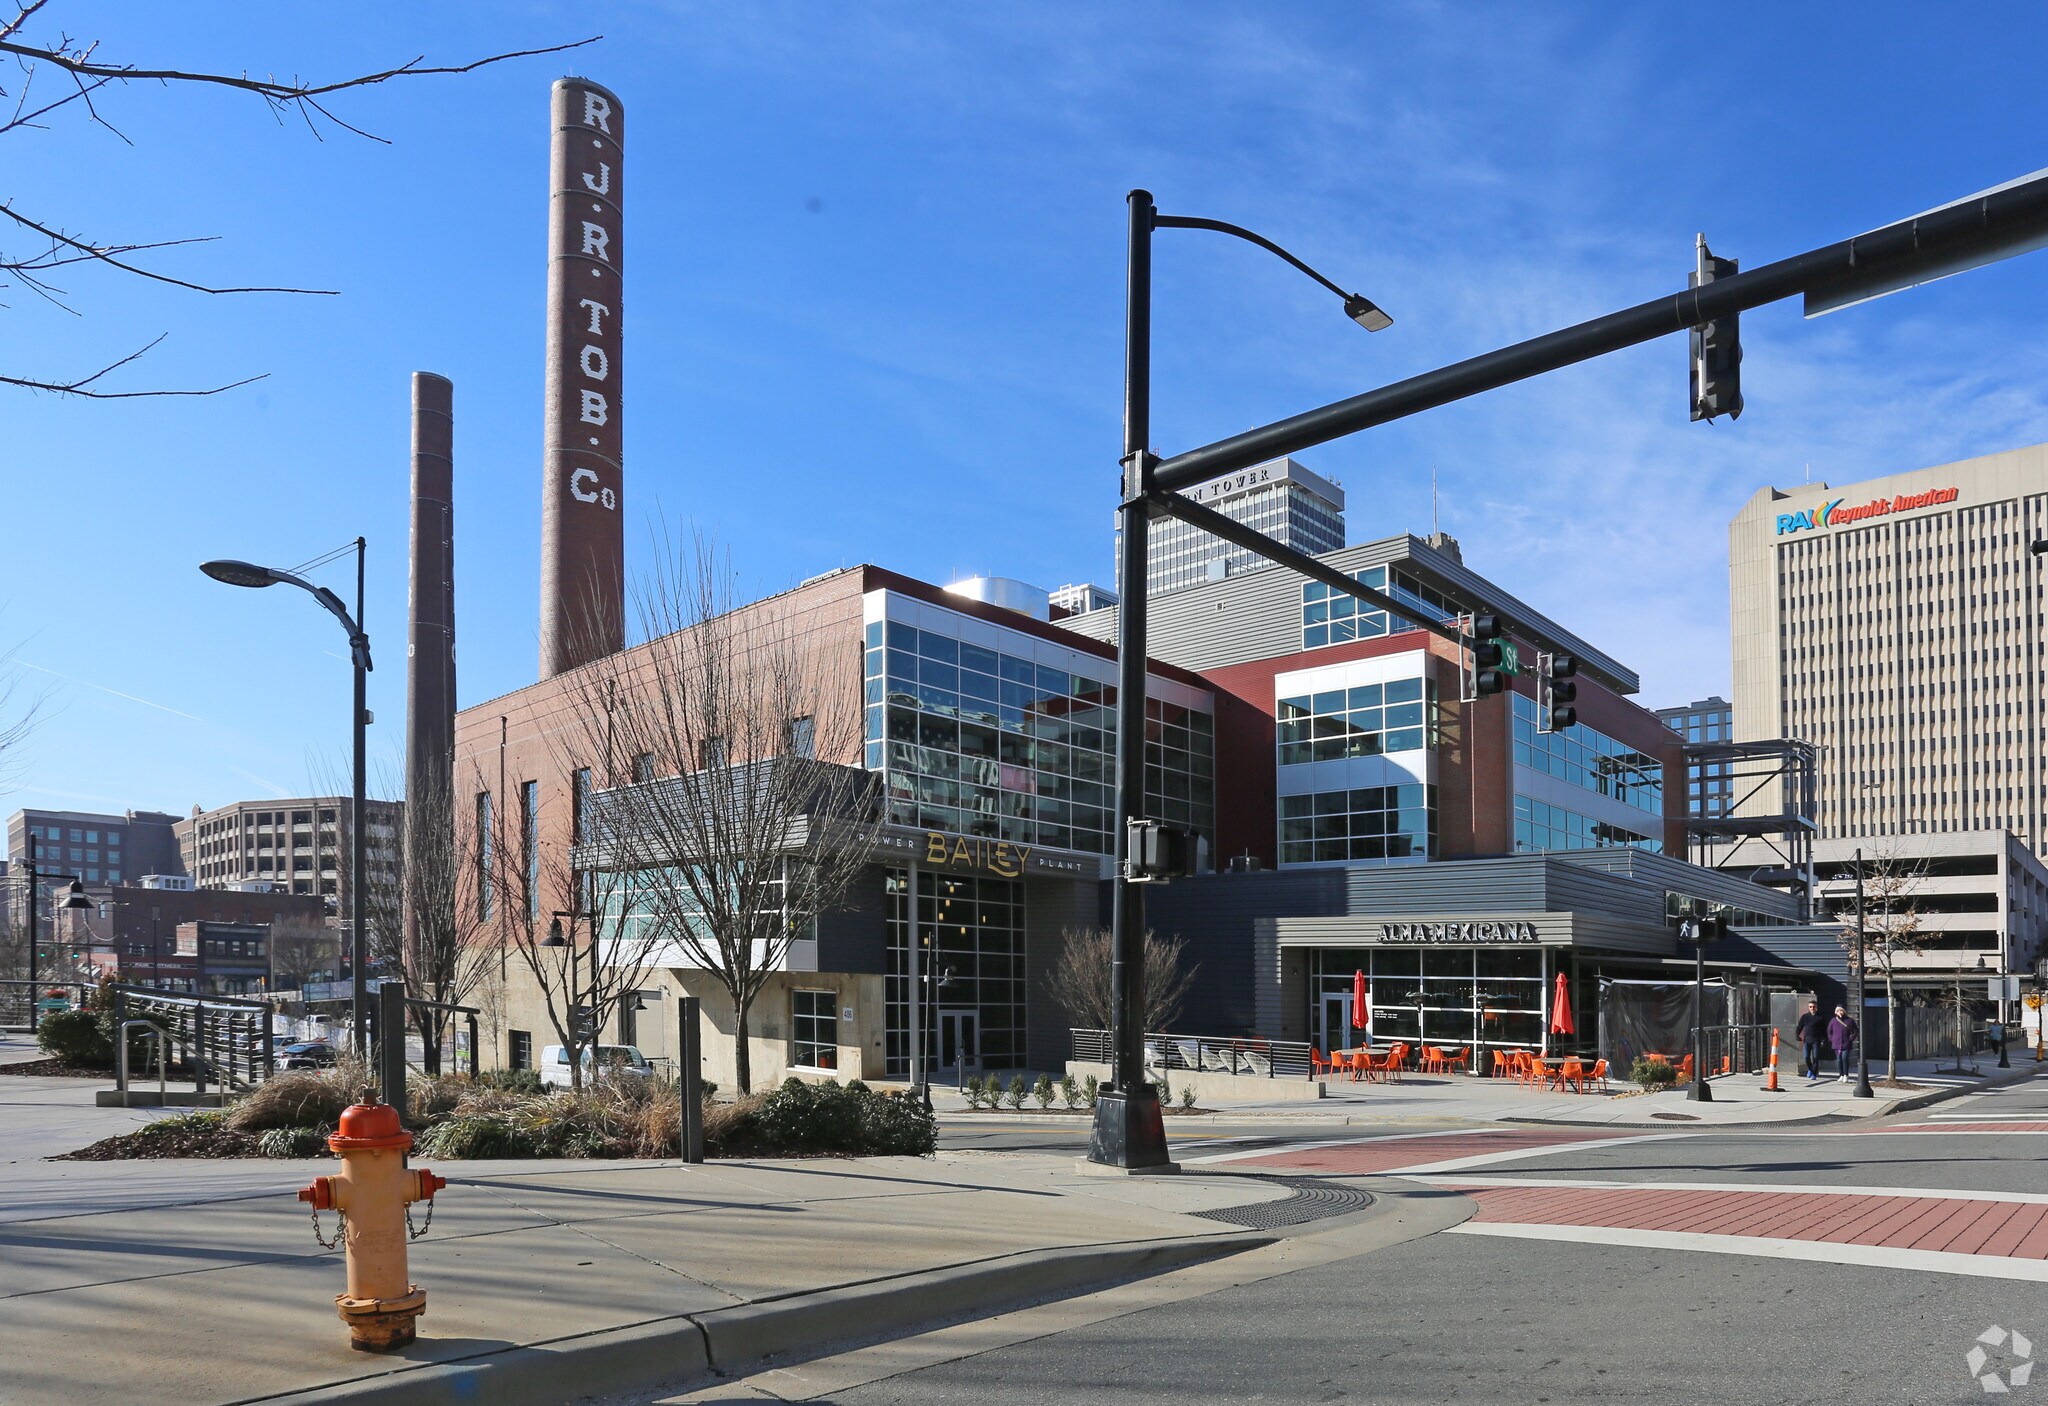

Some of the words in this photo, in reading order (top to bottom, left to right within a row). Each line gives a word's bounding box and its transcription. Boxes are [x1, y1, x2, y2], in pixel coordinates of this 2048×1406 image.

[1211, 468, 1270, 496] TOWER
[1775, 508, 1815, 536] RAI
[1829, 498, 1891, 525] Reynolds
[1891, 486, 1959, 513] American
[1506, 646, 1518, 673] St
[858, 833, 914, 849] POWER
[926, 831, 1032, 878] BAILEY
[1039, 858, 1082, 872] PLANT
[1377, 923, 1428, 942] ALMA
[1432, 921, 1534, 942] MEXICANA
